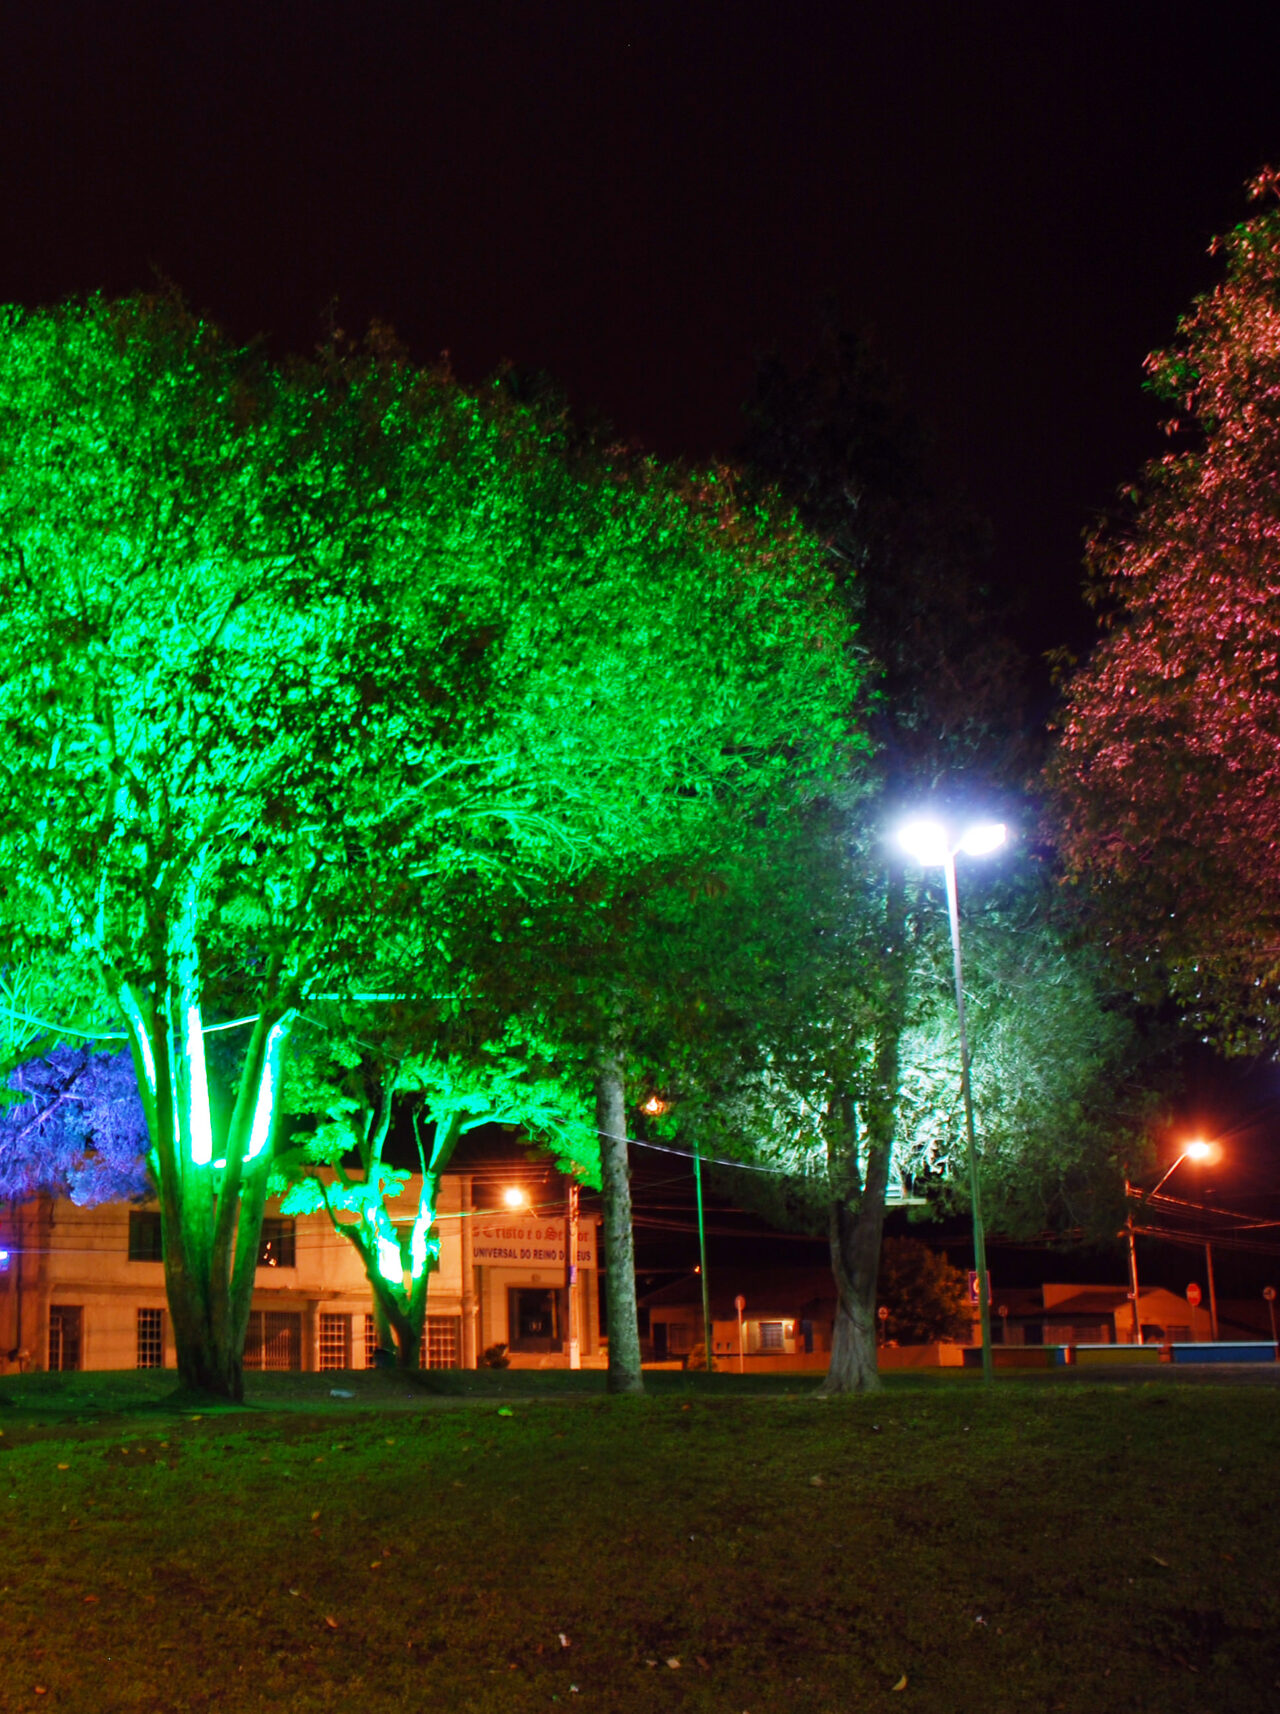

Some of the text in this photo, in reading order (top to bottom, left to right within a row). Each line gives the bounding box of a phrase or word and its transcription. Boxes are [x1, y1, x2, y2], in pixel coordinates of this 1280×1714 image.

[473, 1248, 518, 1259] UNIVERSAL
[520, 1249, 531, 1260] DO
[533, 1249, 556, 1260] REINO
